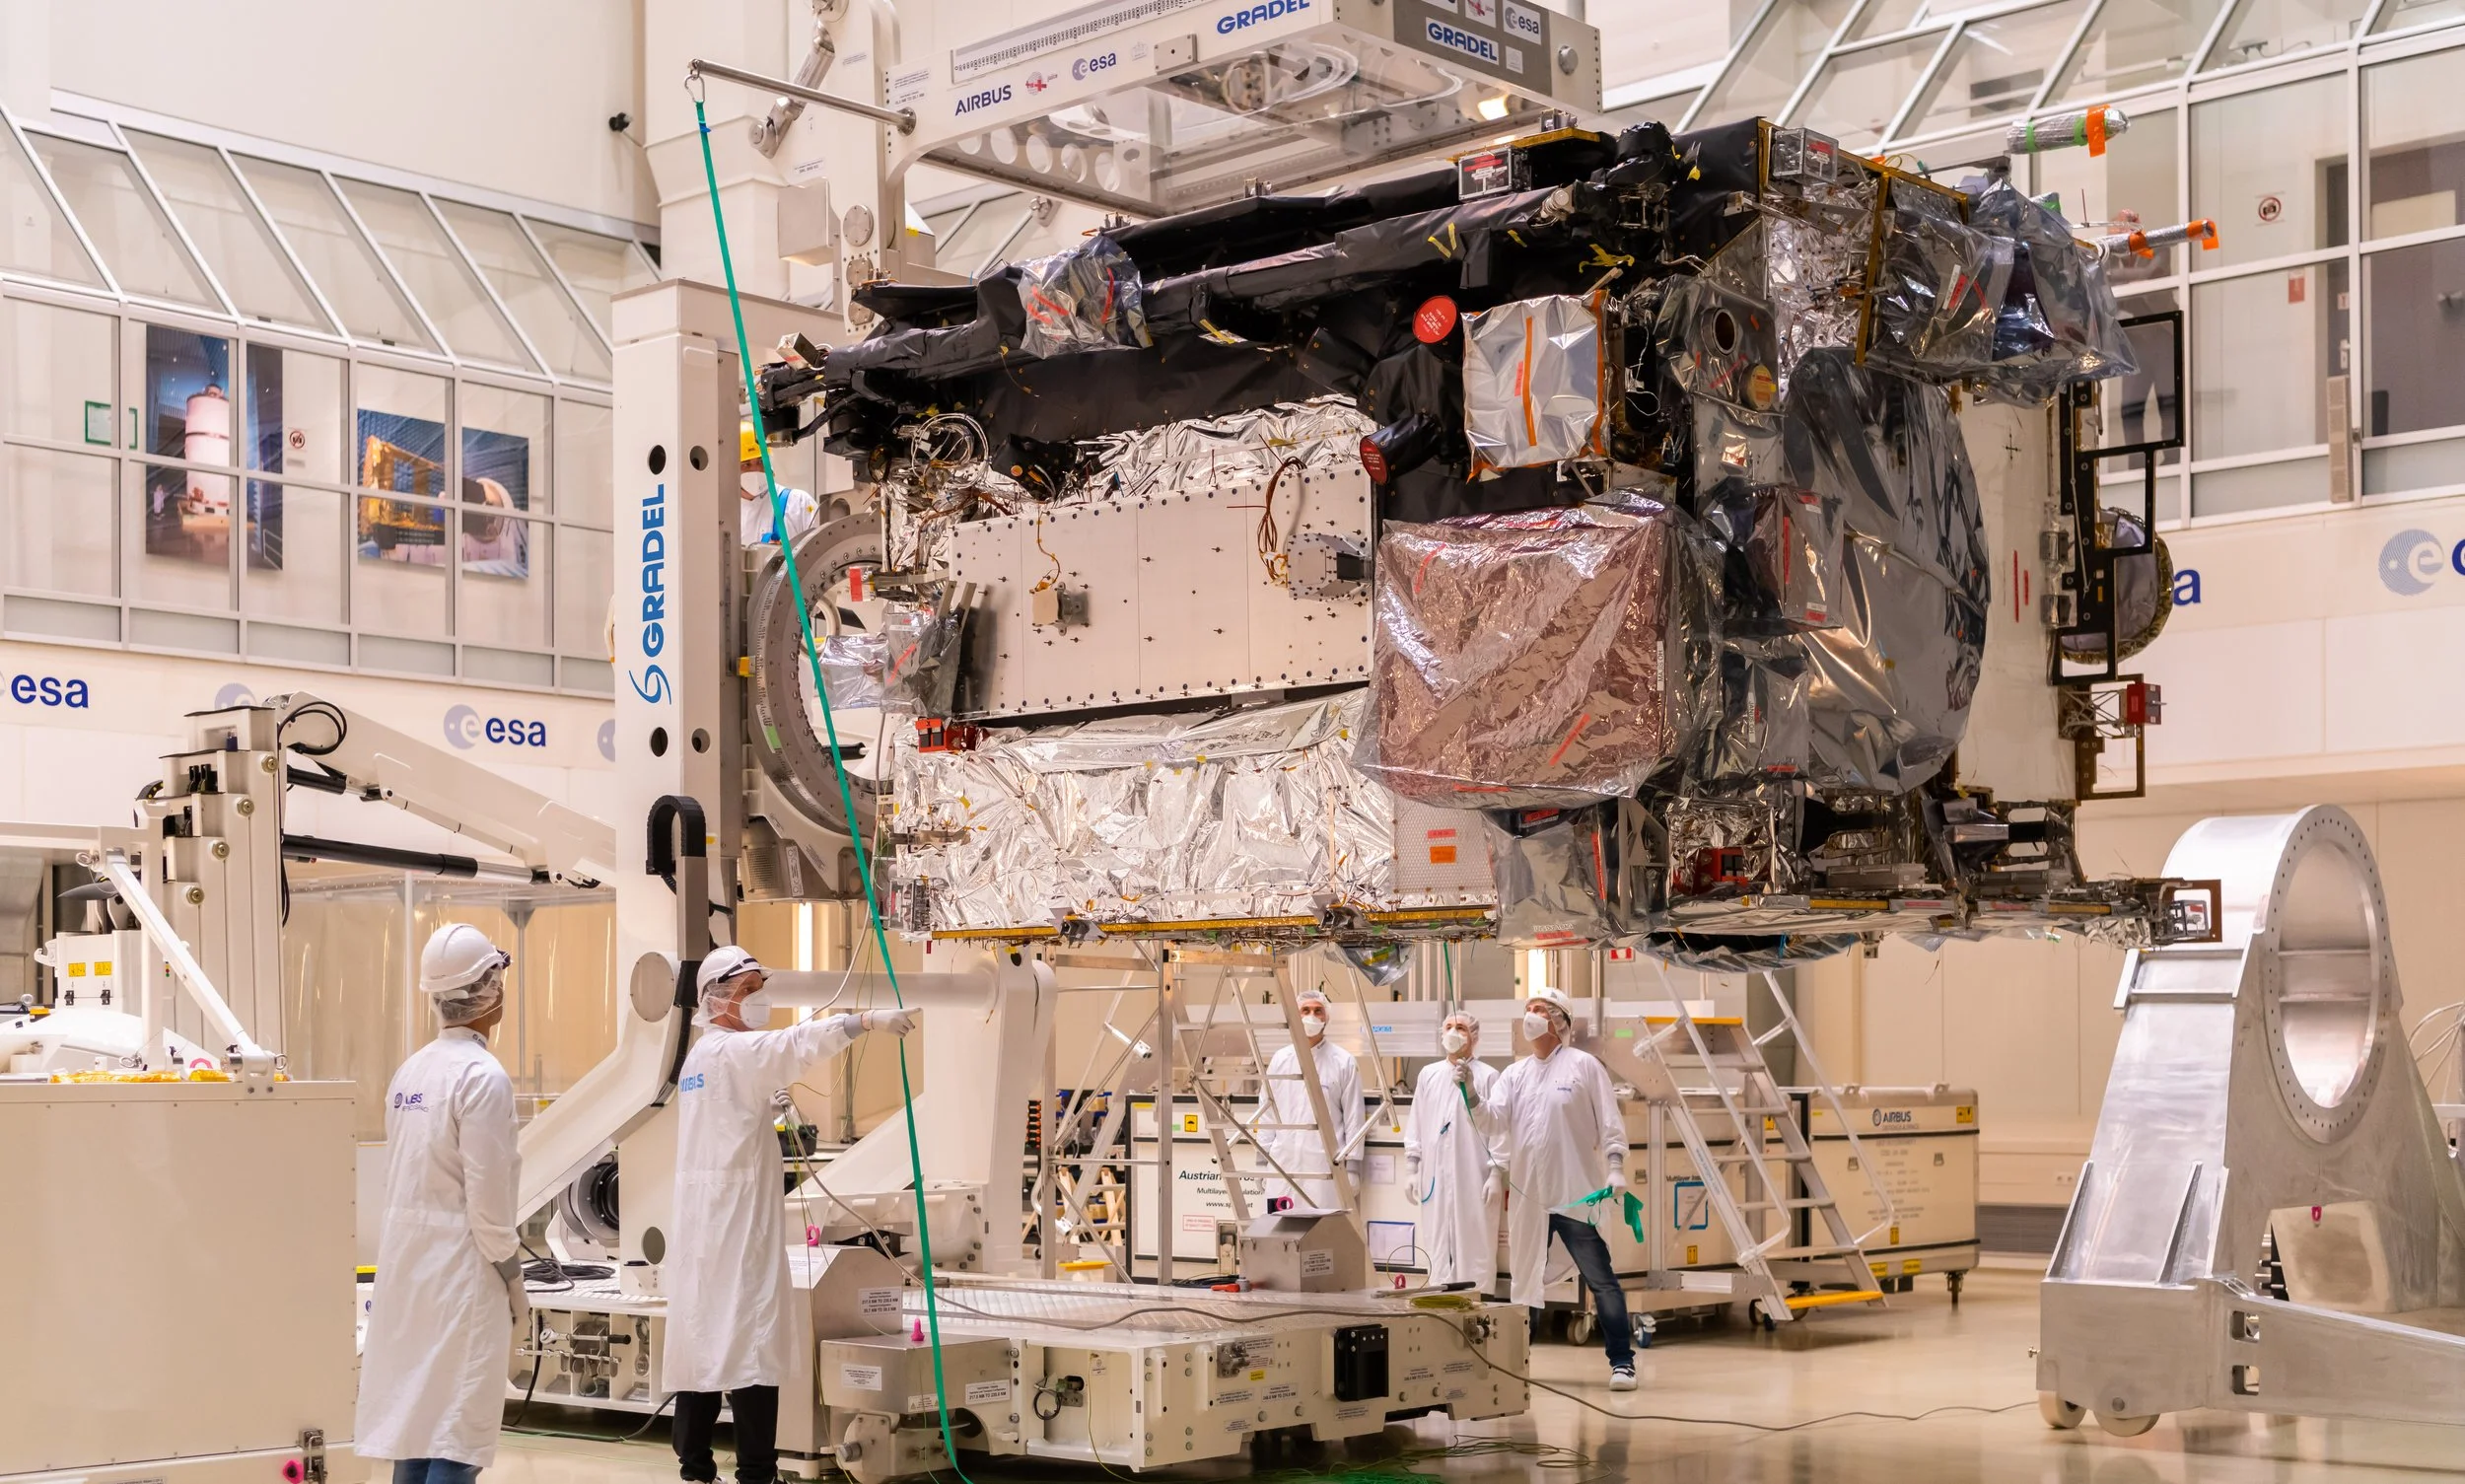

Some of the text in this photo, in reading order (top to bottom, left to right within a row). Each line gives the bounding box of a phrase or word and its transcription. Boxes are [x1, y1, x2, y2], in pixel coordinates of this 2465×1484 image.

[1518, 16, 1539, 35] esa
[1428, 23, 1498, 61] GRADEL
[1089, 52, 1117, 73] esa
[954, 85, 1012, 116] AIRBUS
[642, 483, 665, 658] GRADEL
[11, 673, 89, 709] esa
[485, 717, 546, 747] esa
[1882, 1110, 1912, 1123] AIRBUS
[1178, 1170, 1222, 1180] Austrian
